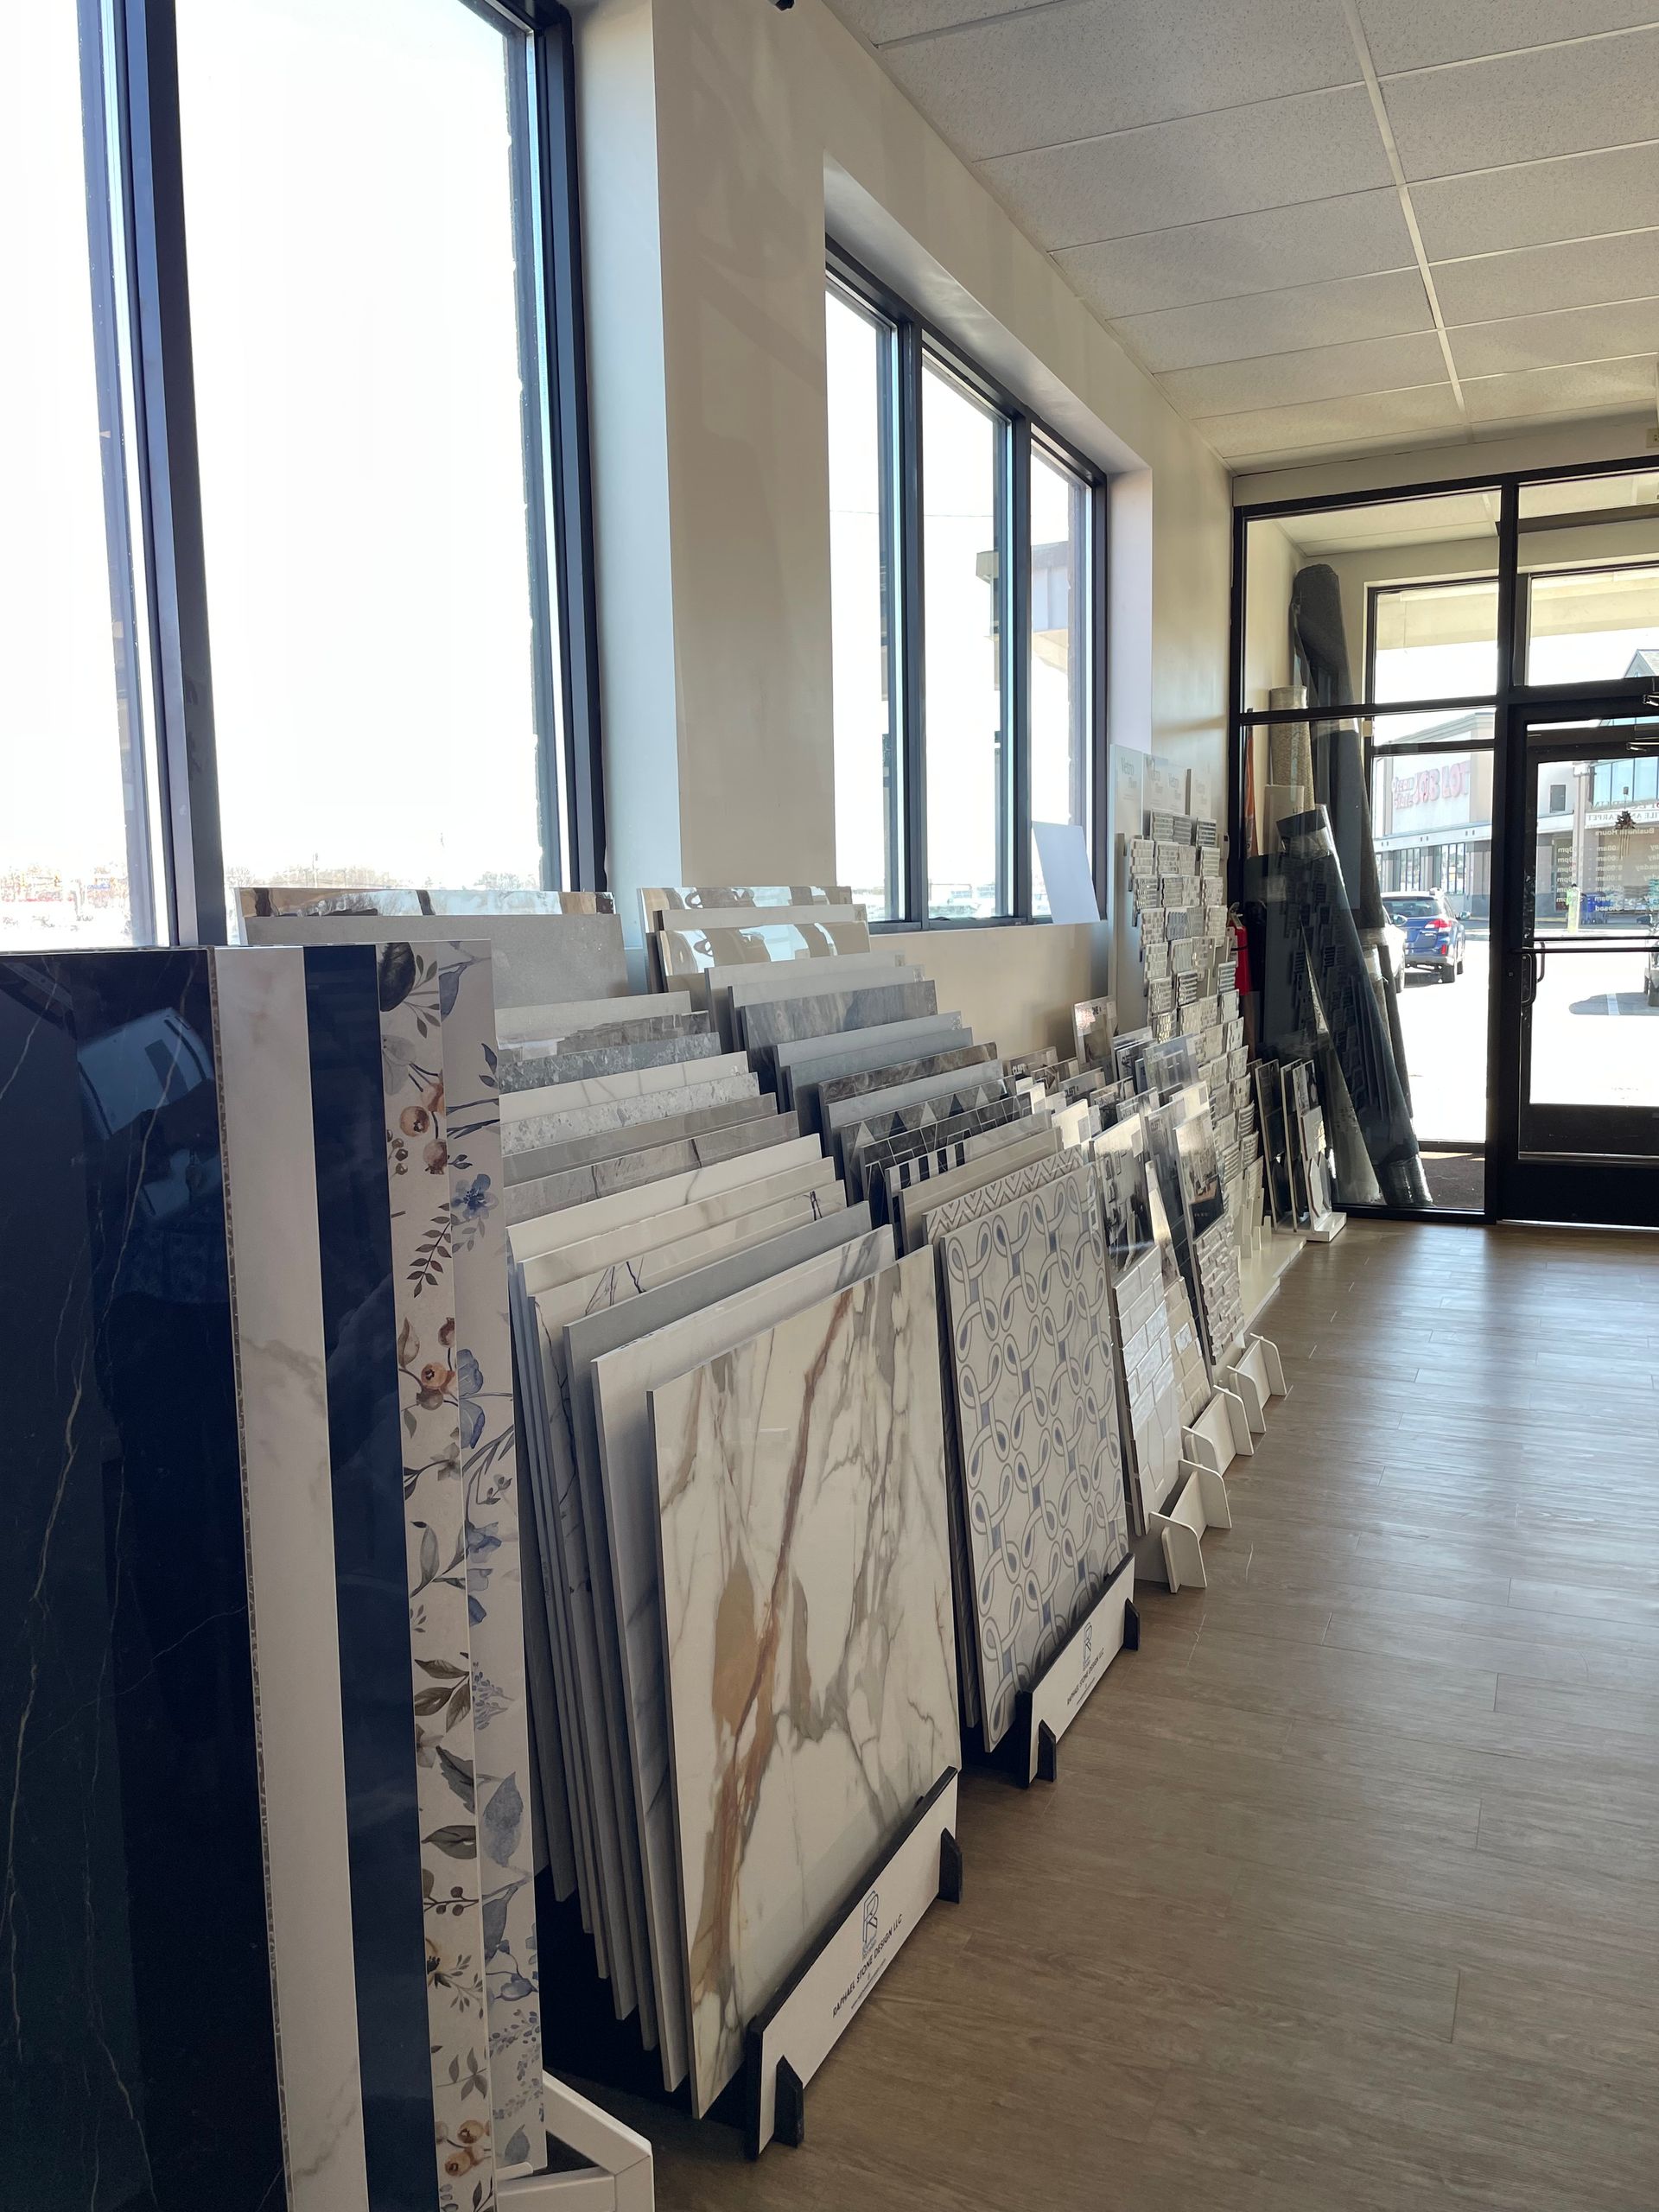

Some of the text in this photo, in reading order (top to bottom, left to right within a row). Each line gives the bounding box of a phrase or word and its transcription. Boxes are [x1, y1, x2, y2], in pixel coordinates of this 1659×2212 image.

[832, 1979, 855, 2018] RAPHAEL
[856, 1954, 873, 1983] STONE
[874, 1928, 893, 1959] DESIGN
[893, 1913, 903, 1932] LLC
